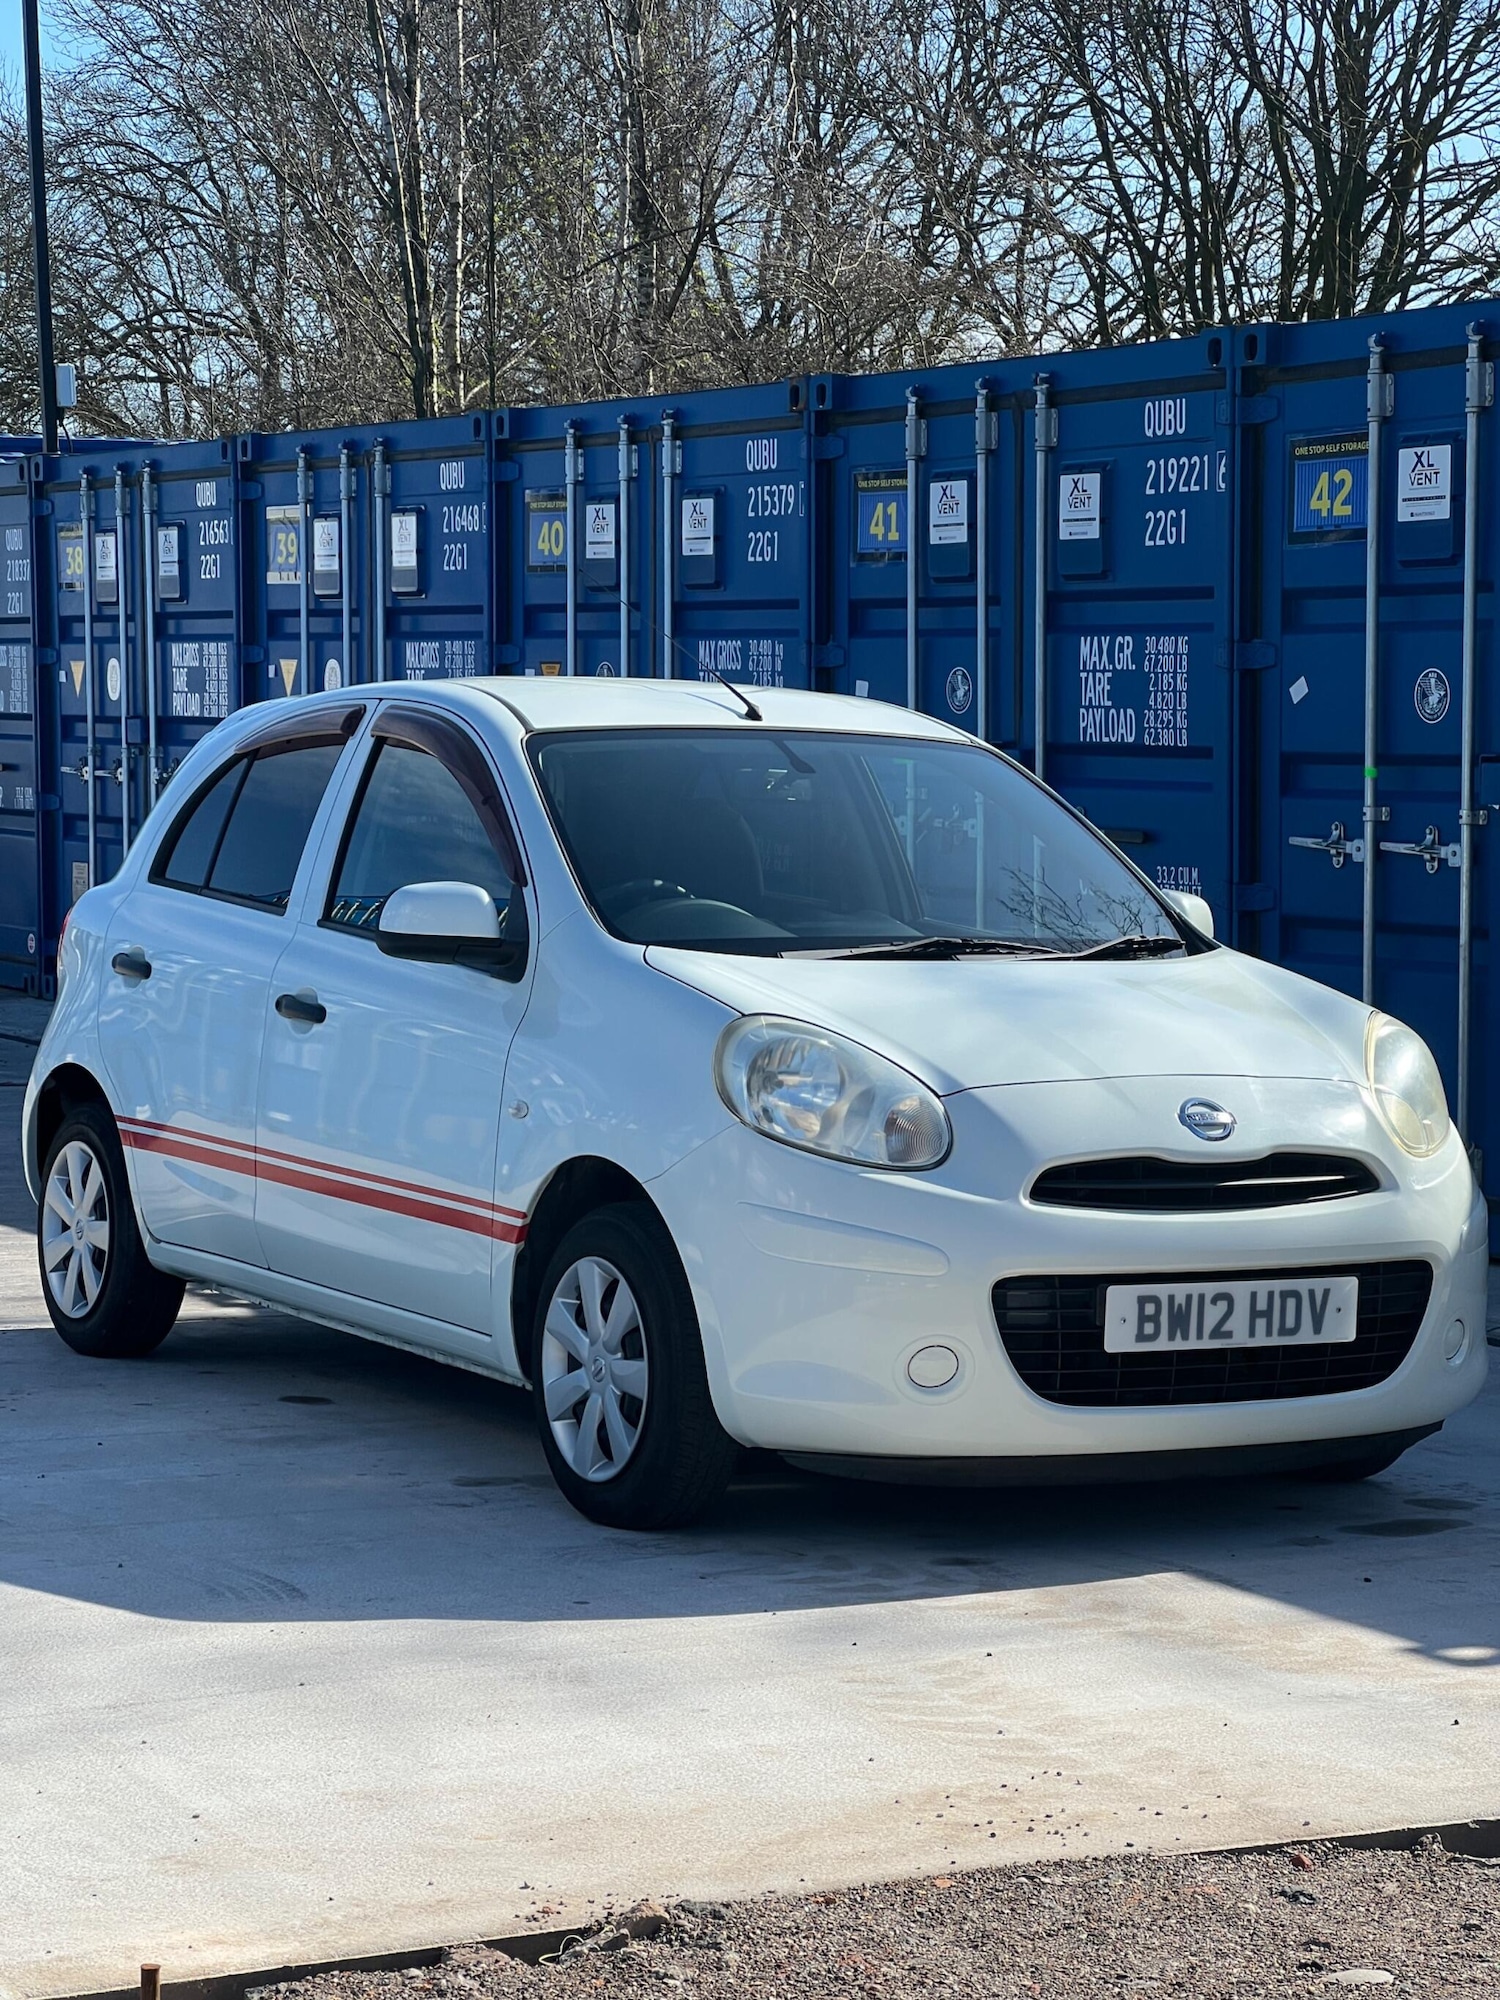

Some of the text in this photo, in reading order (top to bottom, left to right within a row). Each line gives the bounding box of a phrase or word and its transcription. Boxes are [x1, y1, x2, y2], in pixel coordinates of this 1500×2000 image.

[1144, 398, 1186, 438] QUBU
[746, 438, 777, 472] QUBU
[1294, 446, 1309, 456] ONE
[1309, 445, 1325, 455] STOP
[1325, 443, 1340, 453] SELF
[1411, 450, 1435, 472] XL
[440, 461, 464, 490] QUBU
[1145, 454, 1208, 495] 219221
[1408, 471, 1441, 487] VENT
[196, 481, 216, 508] QUBU
[939, 485, 956, 503] XL
[1069, 477, 1088, 497] XL
[1309, 468, 1353, 518] 42
[689, 502, 704, 519] XL
[748, 484, 795, 517] 215379
[937, 502, 960, 514] VENT
[1067, 495, 1092, 509] VENT
[398, 519, 409, 533] XL
[443, 504, 480, 533] 216468
[593, 507, 607, 524] XL
[689, 518, 707, 530] VENT
[870, 501, 899, 542] 41
[199, 519, 229, 546] 216563
[321, 525, 331, 538] XL
[537, 520, 564, 556] 40
[592, 523, 609, 534] VENT
[1144, 508, 1186, 546] 22G1
[6, 529, 22, 551] QUBU
[101, 539, 109, 551] XL
[163, 533, 172, 546] XL
[277, 532, 297, 564] 39
[748, 531, 778, 561] 22G1
[66, 546, 83, 575] 38
[200, 554, 220, 579] 22G1
[443, 543, 467, 570] 22G1
[7, 592, 23, 614] 22G1
[699, 640, 742, 670] MAX GROSS
[748, 640, 783, 660] 30.480 kg
[1144, 636, 1188, 654] 30.480 KG
[748, 656, 772, 671] 67.200
[1143, 655, 1188, 672] 67.200 LB
[1080, 672, 1112, 706] TARE
[1149, 673, 1188, 691] 2.185 KG
[173, 693, 200, 717] PAYLOAD
[1148, 691, 1188, 709] 4.820 LB
[1080, 708, 1136, 742] PAYLOAD
[1144, 709, 1188, 728] 28.295 KG
[1144, 728, 1188, 746] 62.380 LB
[1156, 866, 1175, 884] 33.2
[1135, 1288, 1331, 1344] BW12 HDV
